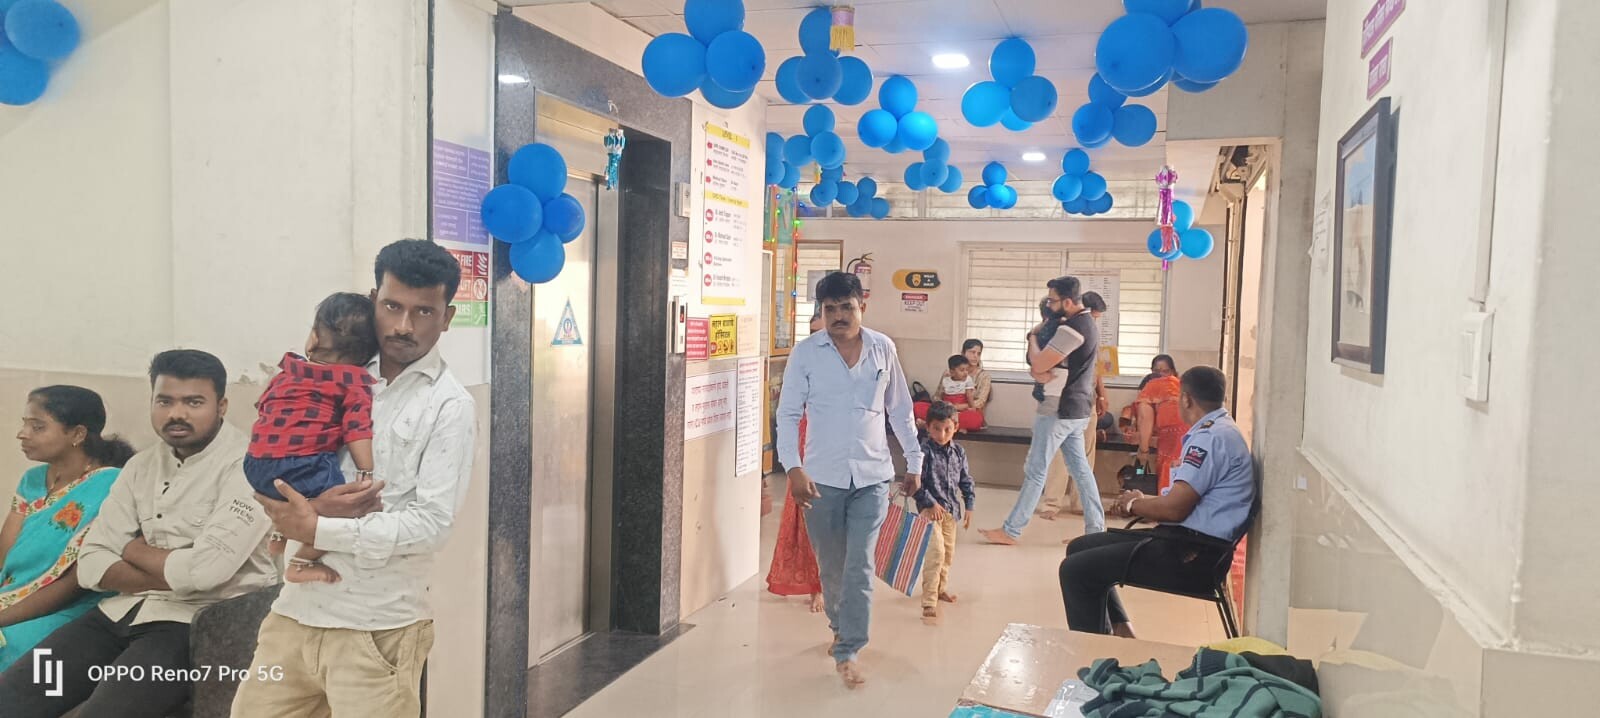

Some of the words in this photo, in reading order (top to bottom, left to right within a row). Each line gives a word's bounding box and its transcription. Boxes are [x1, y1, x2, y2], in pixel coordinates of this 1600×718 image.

[461, 254, 472, 267] FIRE
[232, 499, 254, 512] NOW
[229, 506, 255, 523] TREND
